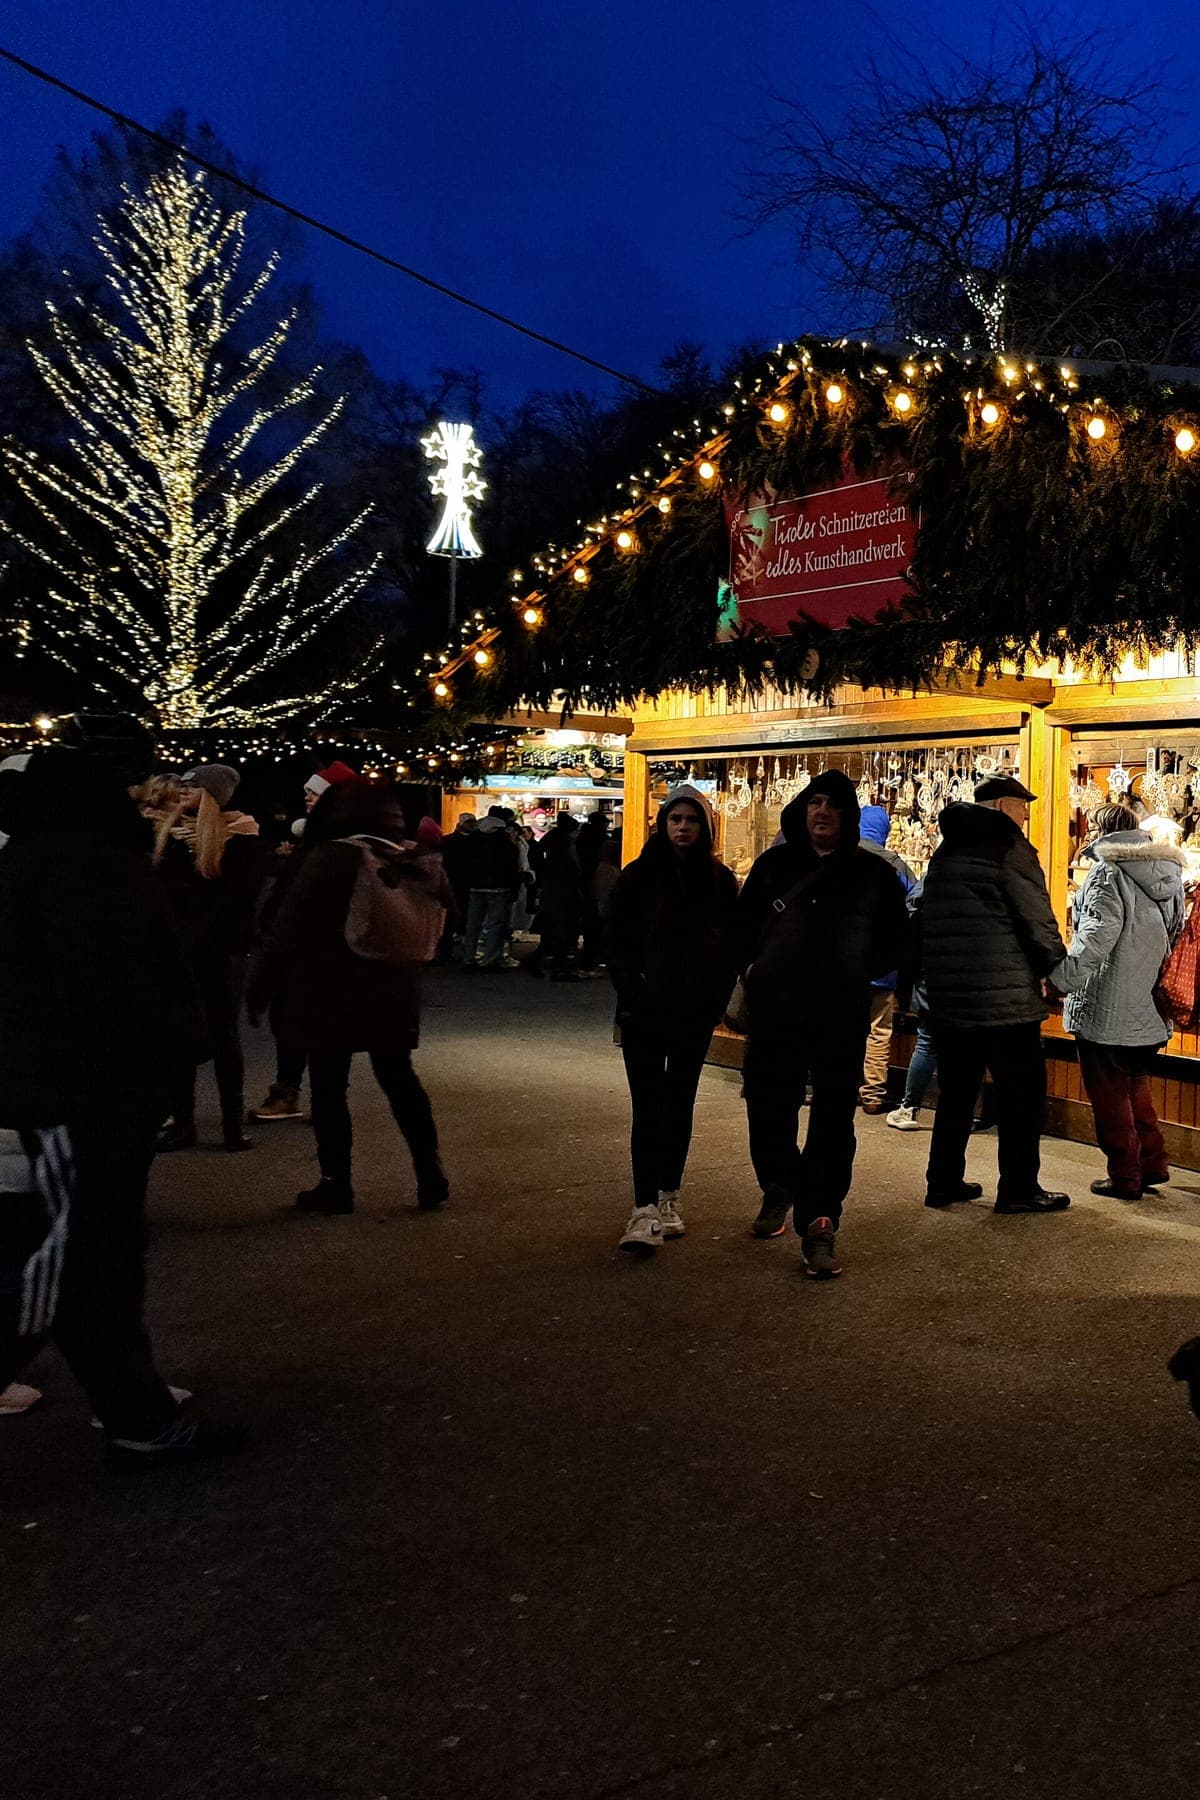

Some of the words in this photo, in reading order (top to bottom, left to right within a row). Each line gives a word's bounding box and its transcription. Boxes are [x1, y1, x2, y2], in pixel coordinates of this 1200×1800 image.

[770, 512, 815, 545] Tiroler
[819, 504, 906, 537] Schnitzereien
[766, 548, 801, 578] edles
[804, 535, 906, 573] Kunsthandwerk
